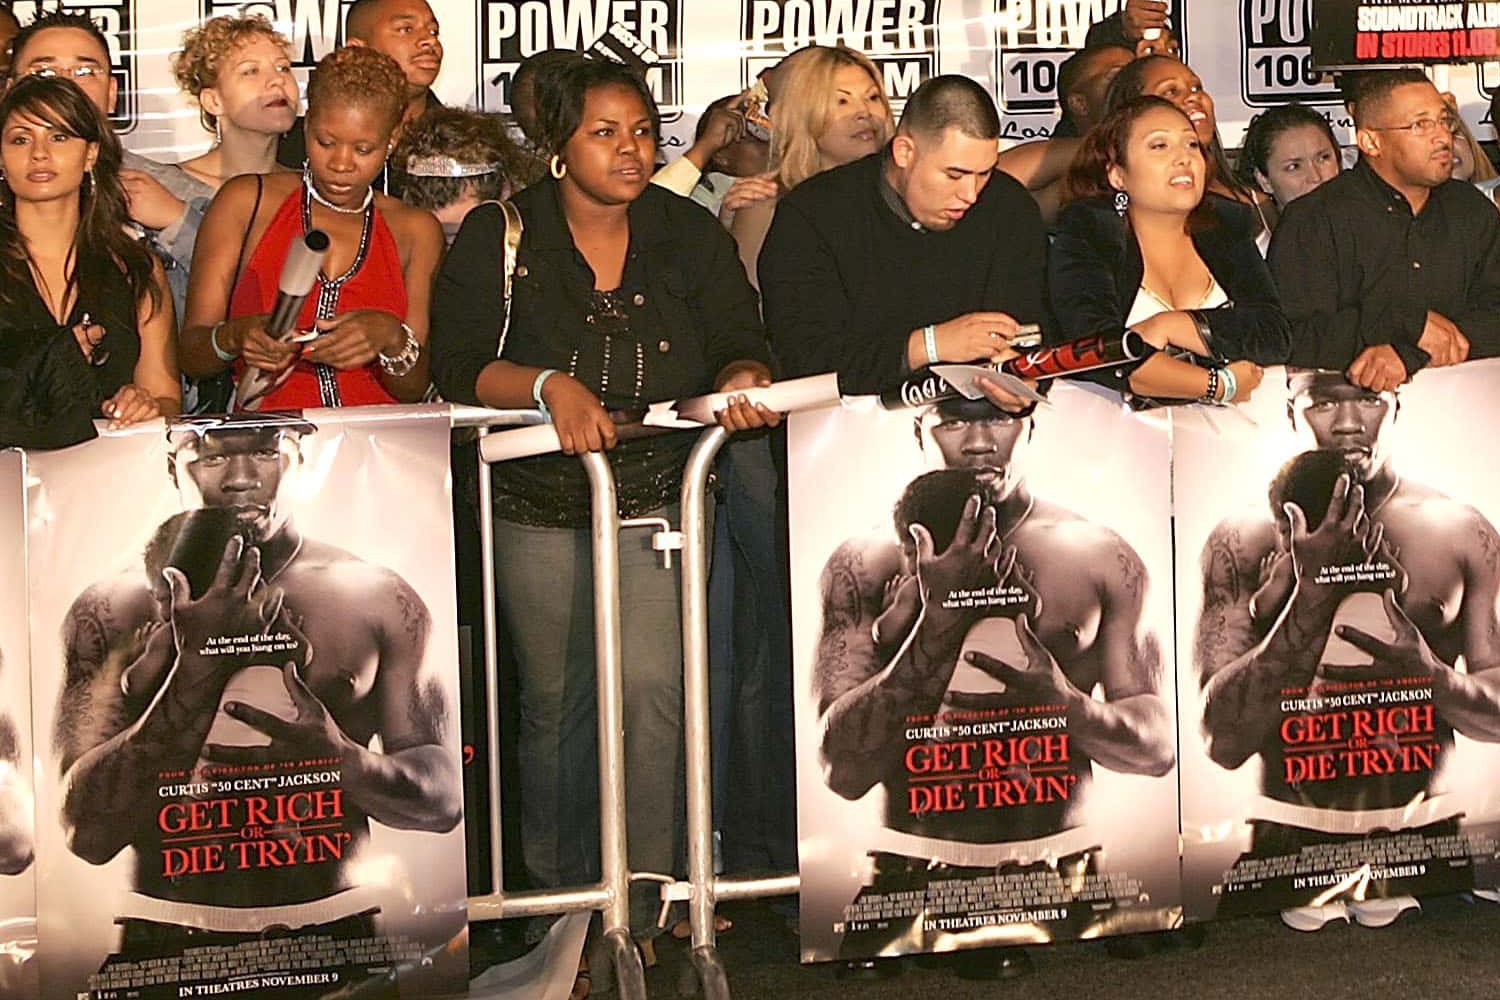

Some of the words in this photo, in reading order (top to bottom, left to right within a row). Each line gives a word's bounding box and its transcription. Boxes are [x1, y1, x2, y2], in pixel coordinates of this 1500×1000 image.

[1357, 5, 1464, 31] SOUNDTRACK
[1356, 31, 1378, 59] IN
[1382, 30, 1450, 57] STORES
[1010, 60, 1056, 94] 10
[1281, 699, 1323, 712] CURTIS
[1379, 689, 1432, 703] JACKSON
[906, 727, 950, 740] CURTIS
[1011, 717, 1067, 731] JACKSON
[1281, 713, 1348, 744] GET
[1353, 705, 1435, 737] RICH
[905, 741, 977, 773] GET
[983, 734, 1069, 768] RICH
[1284, 754, 1336, 783] DIE
[1340, 744, 1440, 777] TRYIN'
[159, 782, 209, 797] CURTIS
[234, 777, 277, 790] CENT"
[278, 771, 341, 787] JACKSON
[978, 767, 1000, 780] OR
[908, 784, 965, 813] DIE
[969, 776, 1077, 808] TRYIN'
[159, 798, 238, 833] GET
[245, 789, 343, 825] RICH
[240, 824, 264, 839] OR
[162, 845, 224, 877] DIE
[230, 832, 351, 869] TRYIN'
[925, 920, 936, 930] IN
[939, 915, 996, 929] THEATRES
[999, 909, 1059, 923] NOVEMBER
[1060, 909, 1067, 919] 9
[179, 987, 193, 997] IN
[195, 977, 259, 994] THEATRES
[262, 973, 330, 987] NOVEMBER
[332, 972, 338, 982] 9
